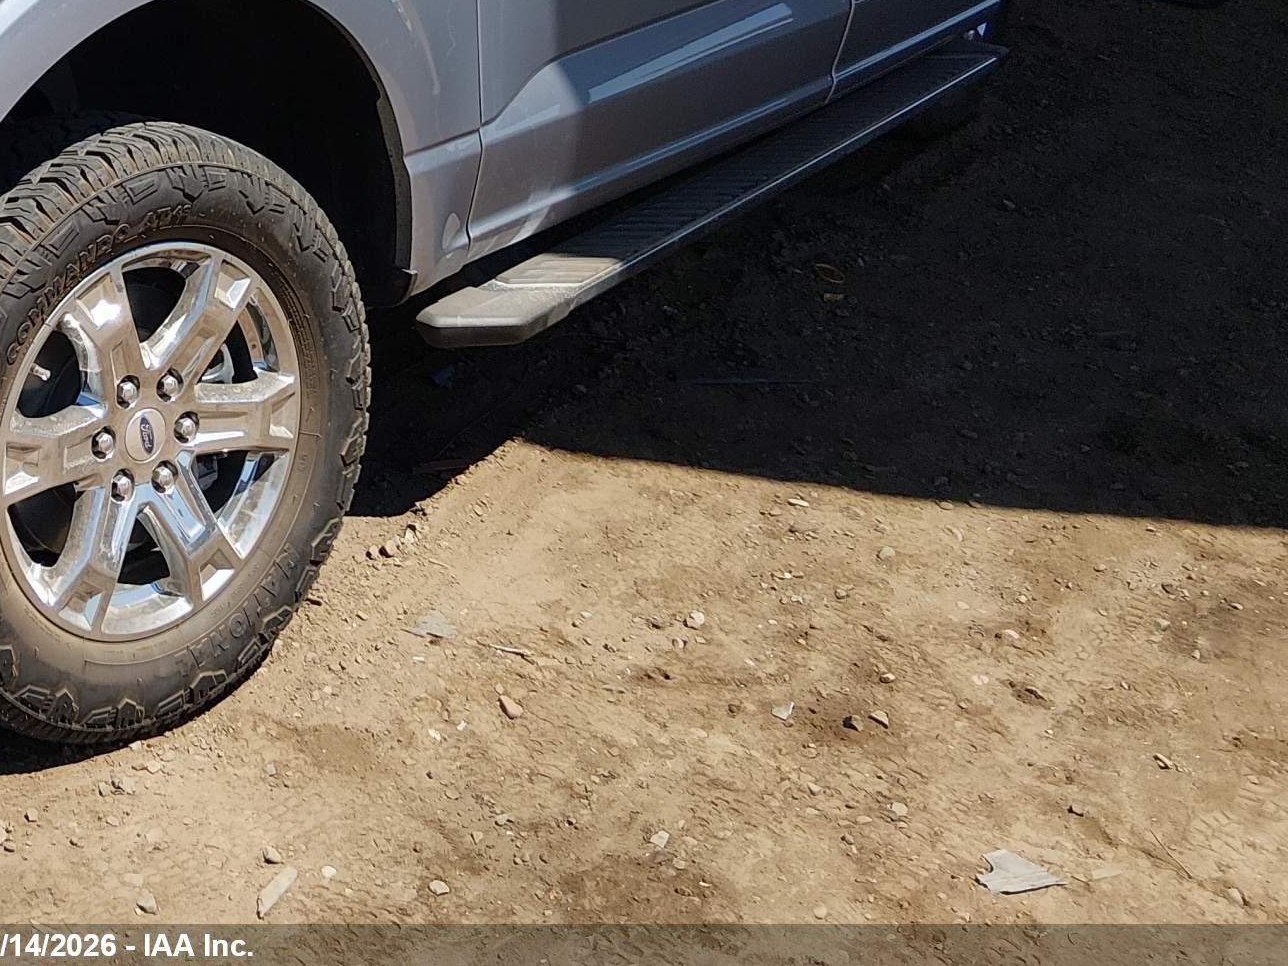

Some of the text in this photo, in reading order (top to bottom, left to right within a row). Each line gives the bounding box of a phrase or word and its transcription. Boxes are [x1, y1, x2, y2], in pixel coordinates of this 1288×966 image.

[6, 222, 130, 366] COMMANDO
[140, 423, 154, 449] Ford
[173, 542, 300, 679] NATIONAL
